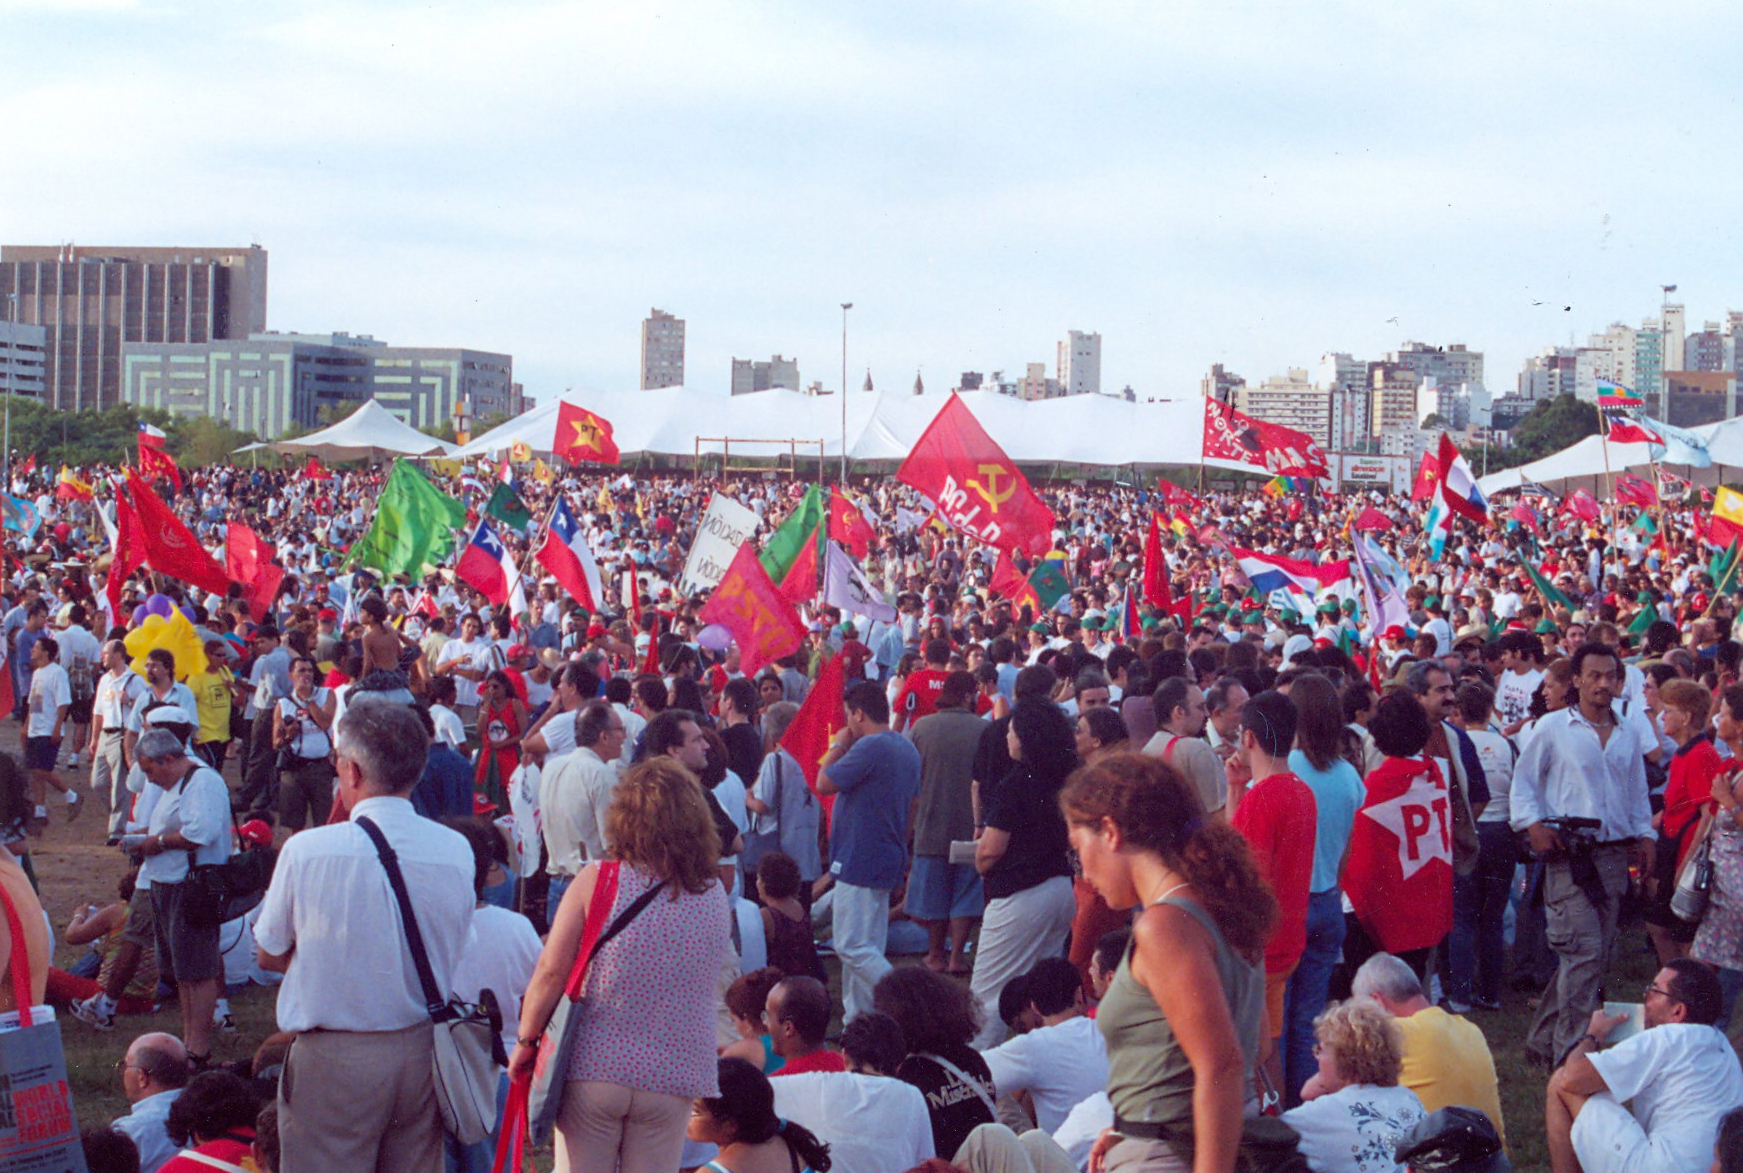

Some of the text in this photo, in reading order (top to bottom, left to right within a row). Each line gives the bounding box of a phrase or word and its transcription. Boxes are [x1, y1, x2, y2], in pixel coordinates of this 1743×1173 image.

[581, 424, 599, 441] PT
[719, 571, 793, 657] PSTU
[1401, 796, 1449, 861] PT
[12, 1079, 69, 1109] WORLD
[15, 1099, 72, 1127] SOCIAL
[18, 1115, 73, 1145] FORUM
